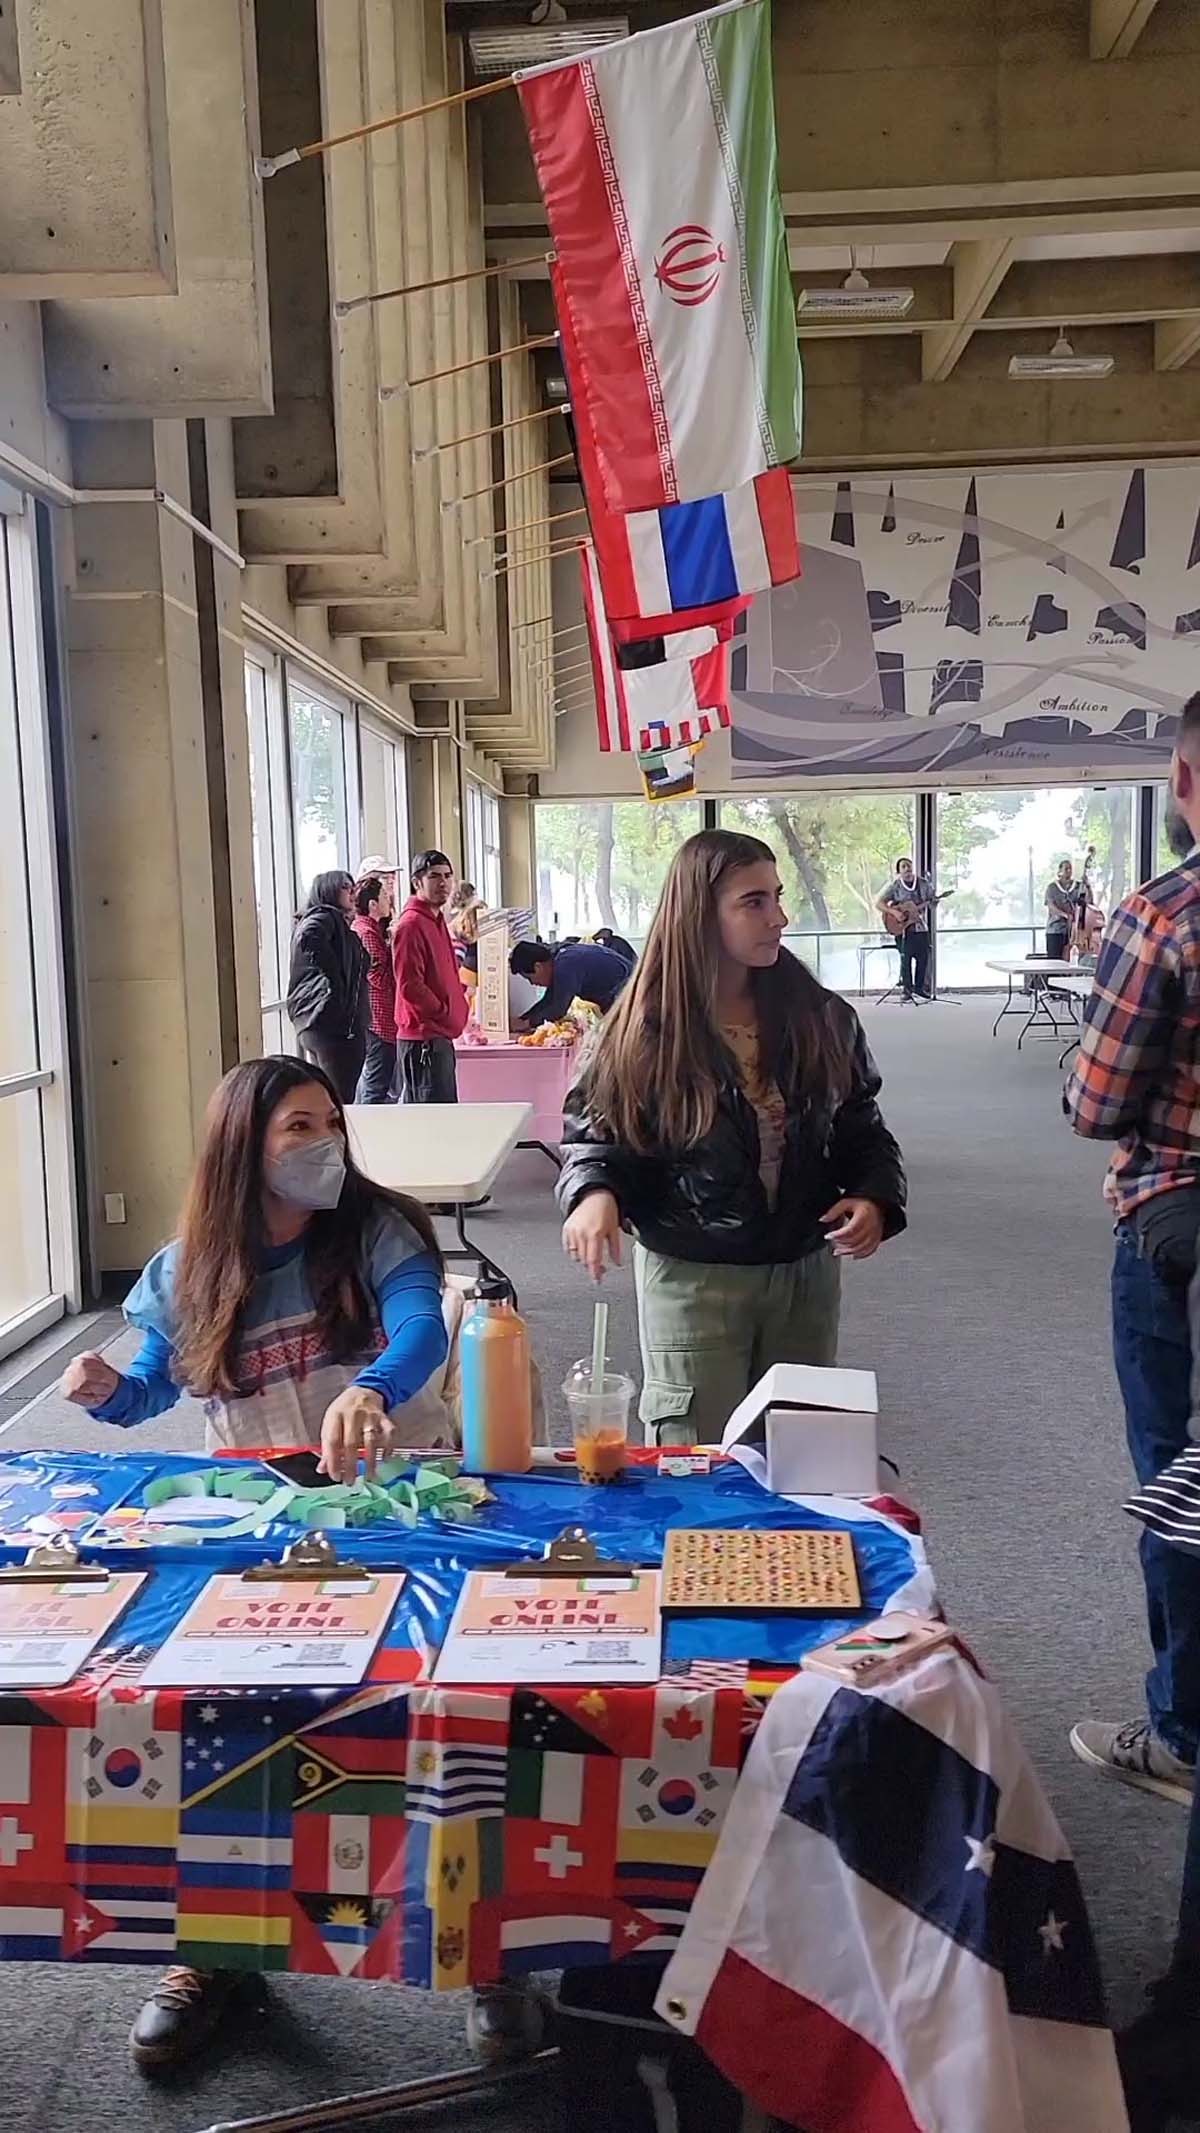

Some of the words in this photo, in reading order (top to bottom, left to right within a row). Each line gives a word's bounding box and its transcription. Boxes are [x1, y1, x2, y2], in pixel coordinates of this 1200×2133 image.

[1039, 695, 1109, 713] Ambition
[216, 1616, 351, 1629] ONLINE
[488, 1613, 621, 1626] ONLINE
